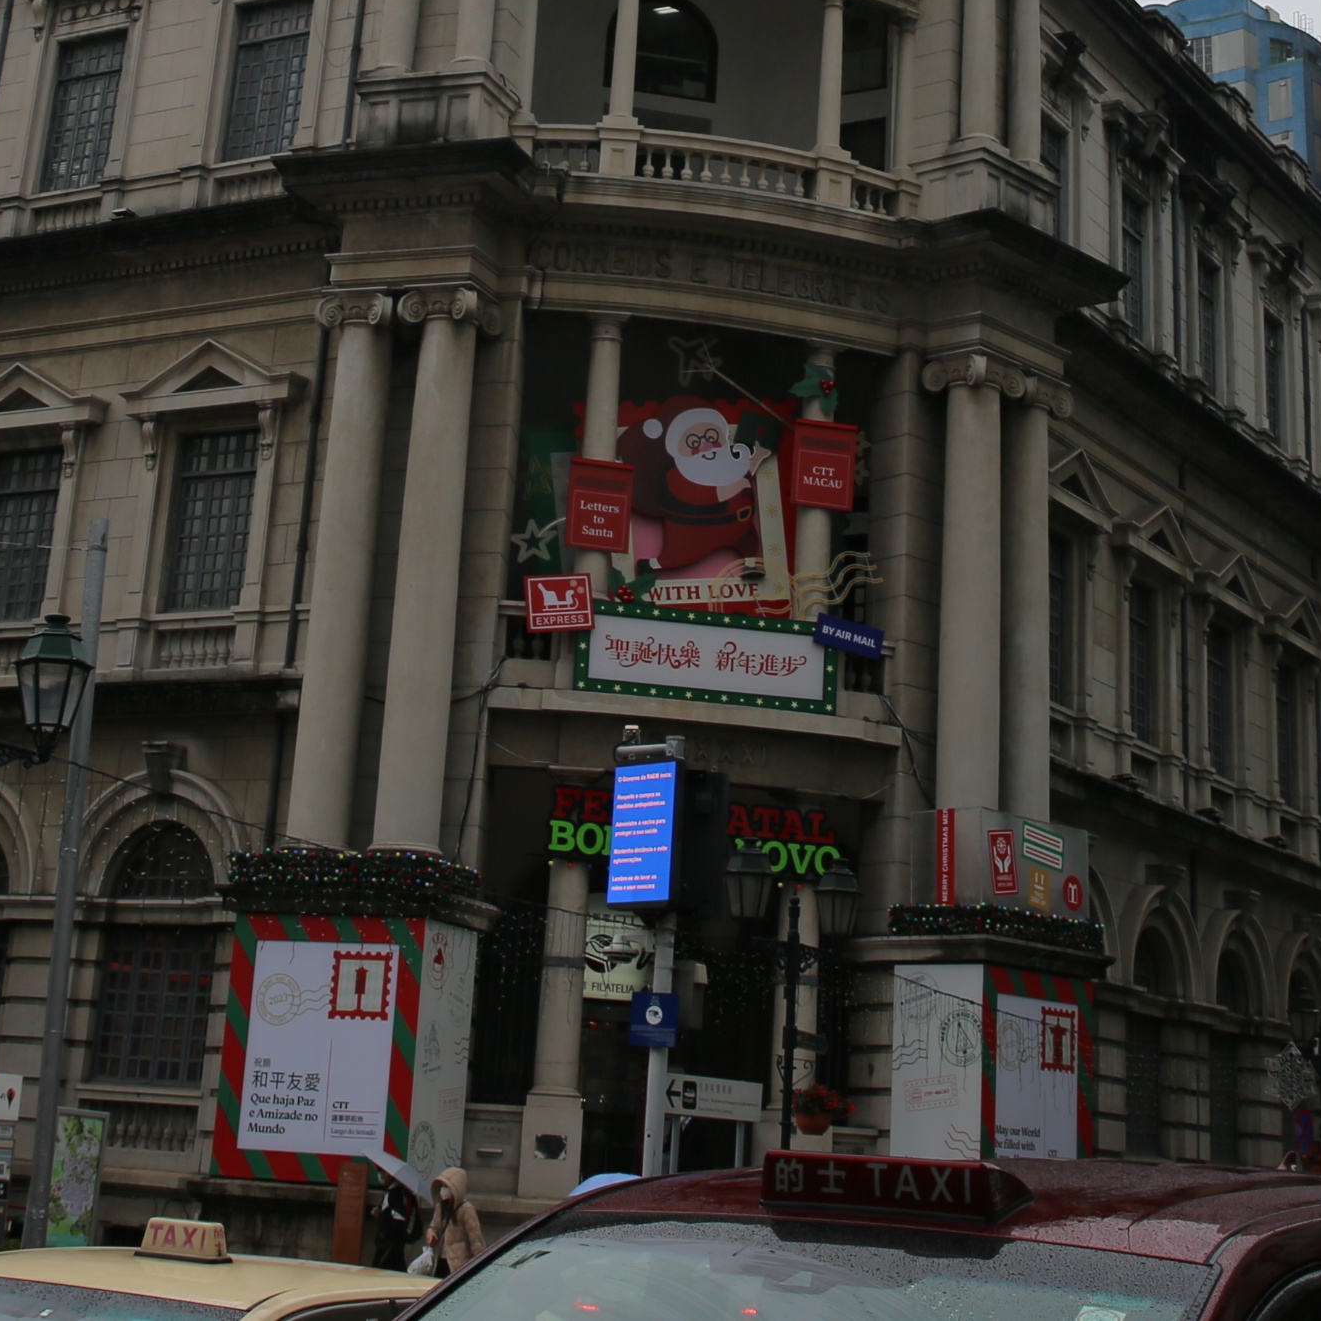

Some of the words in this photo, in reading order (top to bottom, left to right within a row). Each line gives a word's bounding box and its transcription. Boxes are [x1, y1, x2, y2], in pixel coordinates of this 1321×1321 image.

[812, 465, 835, 477] CTT
[802, 476, 843, 489] MACAU
[580, 499, 619, 514] Letters
[593, 514, 605, 525] to
[581, 524, 614, 539] Santa
[648, 582, 702, 601] WITH
[708, 581, 760, 600] LOVE
[535, 614, 584, 627] EXPRESS
[822, 624, 836, 638] BY
[836, 628, 853, 642] AIR
[853, 632, 877, 649] MAIL
[605, 634, 701, 669] 聖誕快樂
[715, 641, 807, 677] 新年進步
[553, 786, 610, 824] FE
[727, 804, 836, 845] ATAL
[735, 837, 842, 877] OVO
[591, 981, 635, 994] FILATELIA
[268, 994, 289, 1005] 2023
[254, 1058, 271, 1068] 祝願
[251, 1070, 321, 1092] 和平友愛
[250, 1093, 271, 1106] Que
[273, 1094, 295, 1107] haja
[297, 1096, 315, 1106] Paz
[332, 1101, 350, 1110] CTT
[249, 1110, 255, 1118] e
[255, 1108, 303, 1121] Amizade
[304, 1113, 318, 1122] no
[247, 1122, 286, 1135] Mundo
[330, 1127, 347, 1136] Largo
[355, 1128, 377, 1136] Senado
[995, 1124, 1008, 1138] May
[1009, 1127, 1021, 1137] our
[1021, 1126, 1041, 1138] World
[995, 1138, 1003, 1149] be
[1003, 1138, 1021, 1150] filled
[1021, 1141, 1036, 1152] with
[775, 1158, 847, 1194] 的士
[866, 1162, 971, 1205] TAXI
[149, 1223, 207, 1252] TAXI
